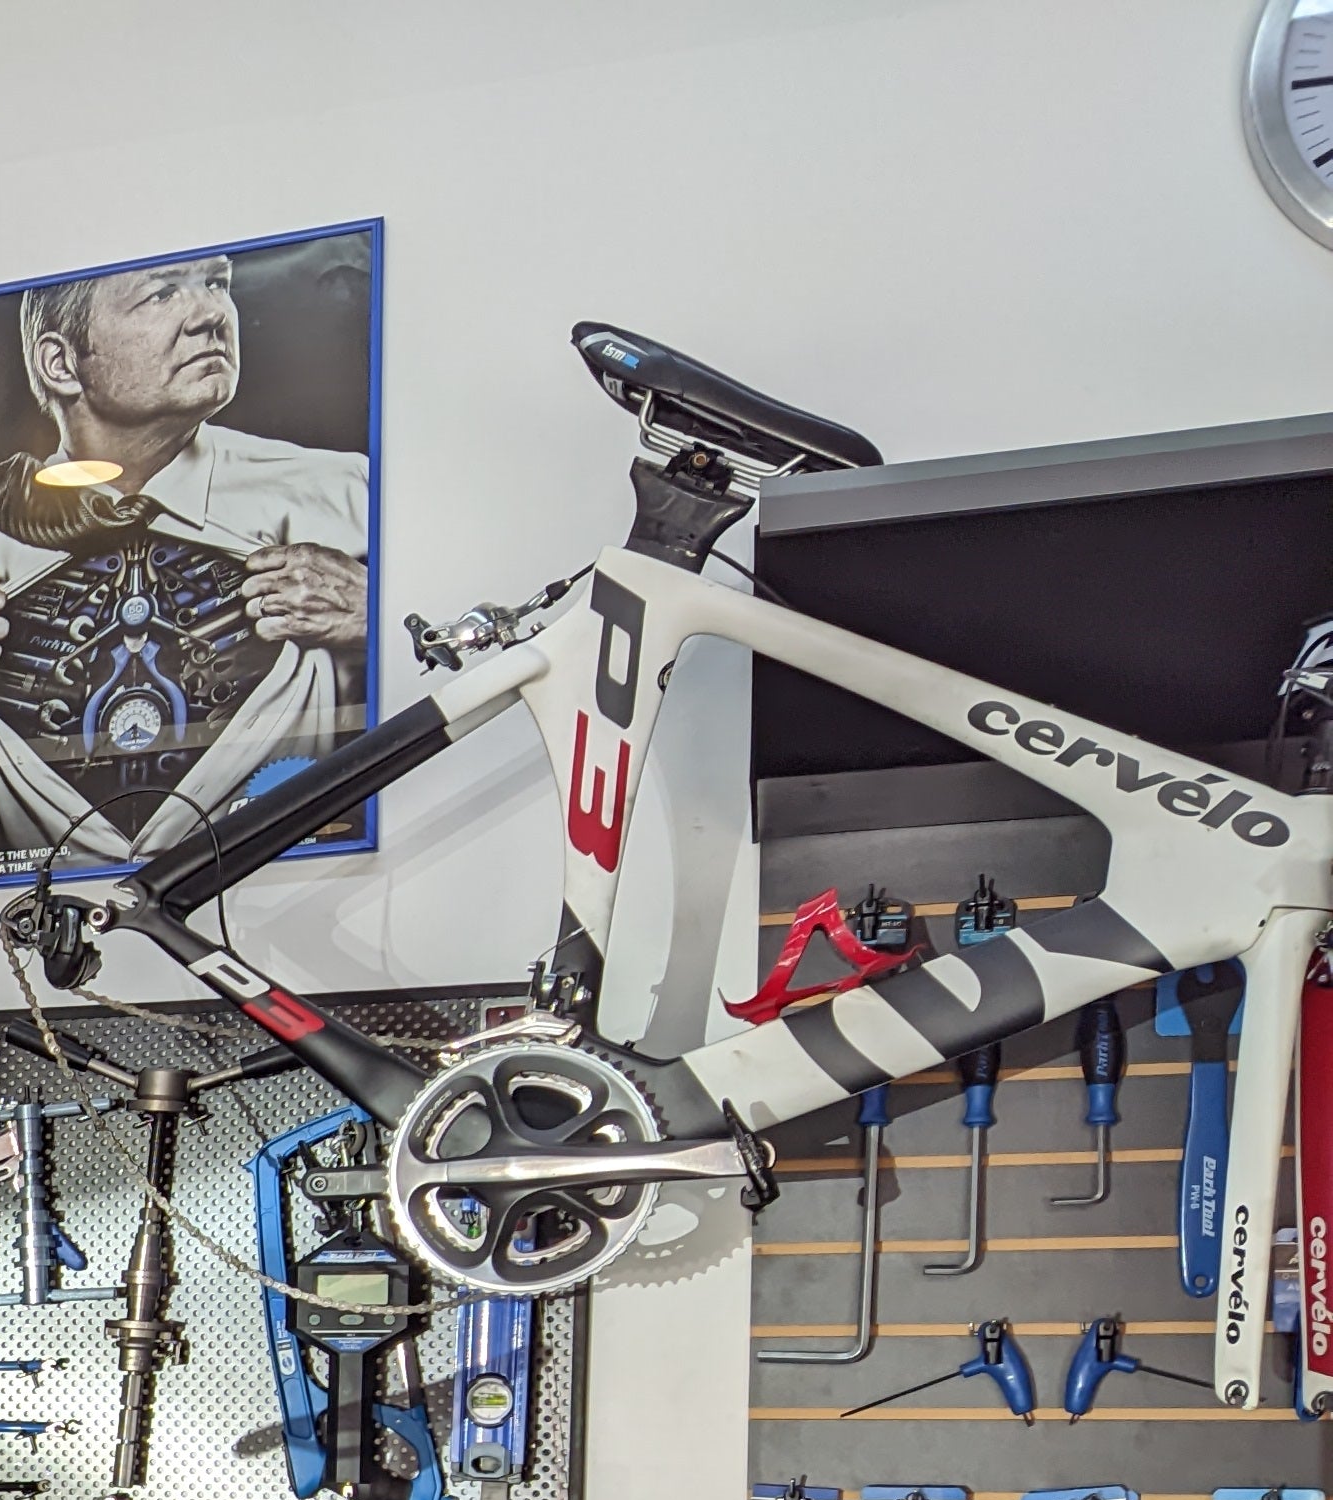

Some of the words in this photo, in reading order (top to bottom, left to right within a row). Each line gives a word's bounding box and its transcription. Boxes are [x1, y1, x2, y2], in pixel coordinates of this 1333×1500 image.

[967, 701, 1290, 847] cervélo
[6, 849, 27, 861] THE
[28, 845, 72, 860] WORD,
[8, 862, 37, 874] TIME.
[1226, 1204, 1249, 1345] cervélo
